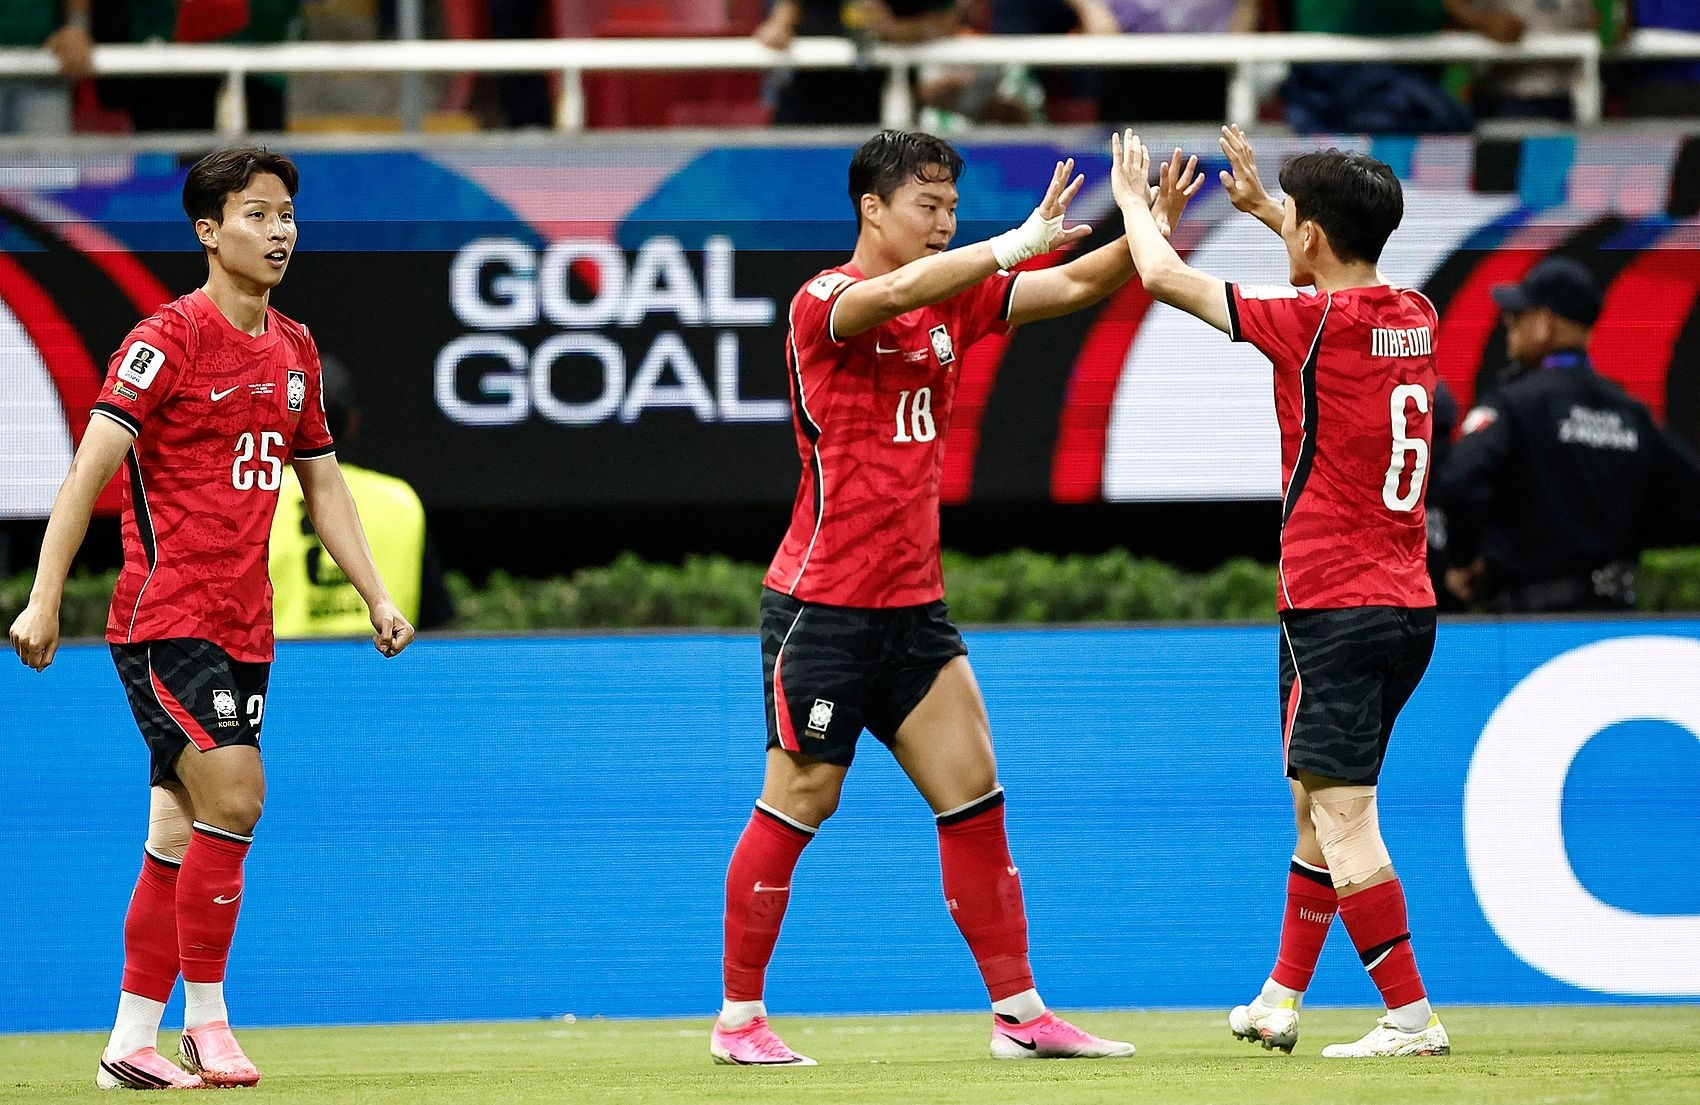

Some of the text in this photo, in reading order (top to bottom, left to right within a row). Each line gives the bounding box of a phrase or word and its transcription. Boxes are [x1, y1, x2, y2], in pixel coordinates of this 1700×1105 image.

[449, 235, 776, 328] GOAL
[1371, 327, 1432, 357] INBEOM
[433, 331, 790, 425] GOAL
[892, 387, 937, 443] 18
[232, 431, 285, 491] 25
[1382, 384, 1430, 512] 6
[218, 720, 240, 728] KOREA
